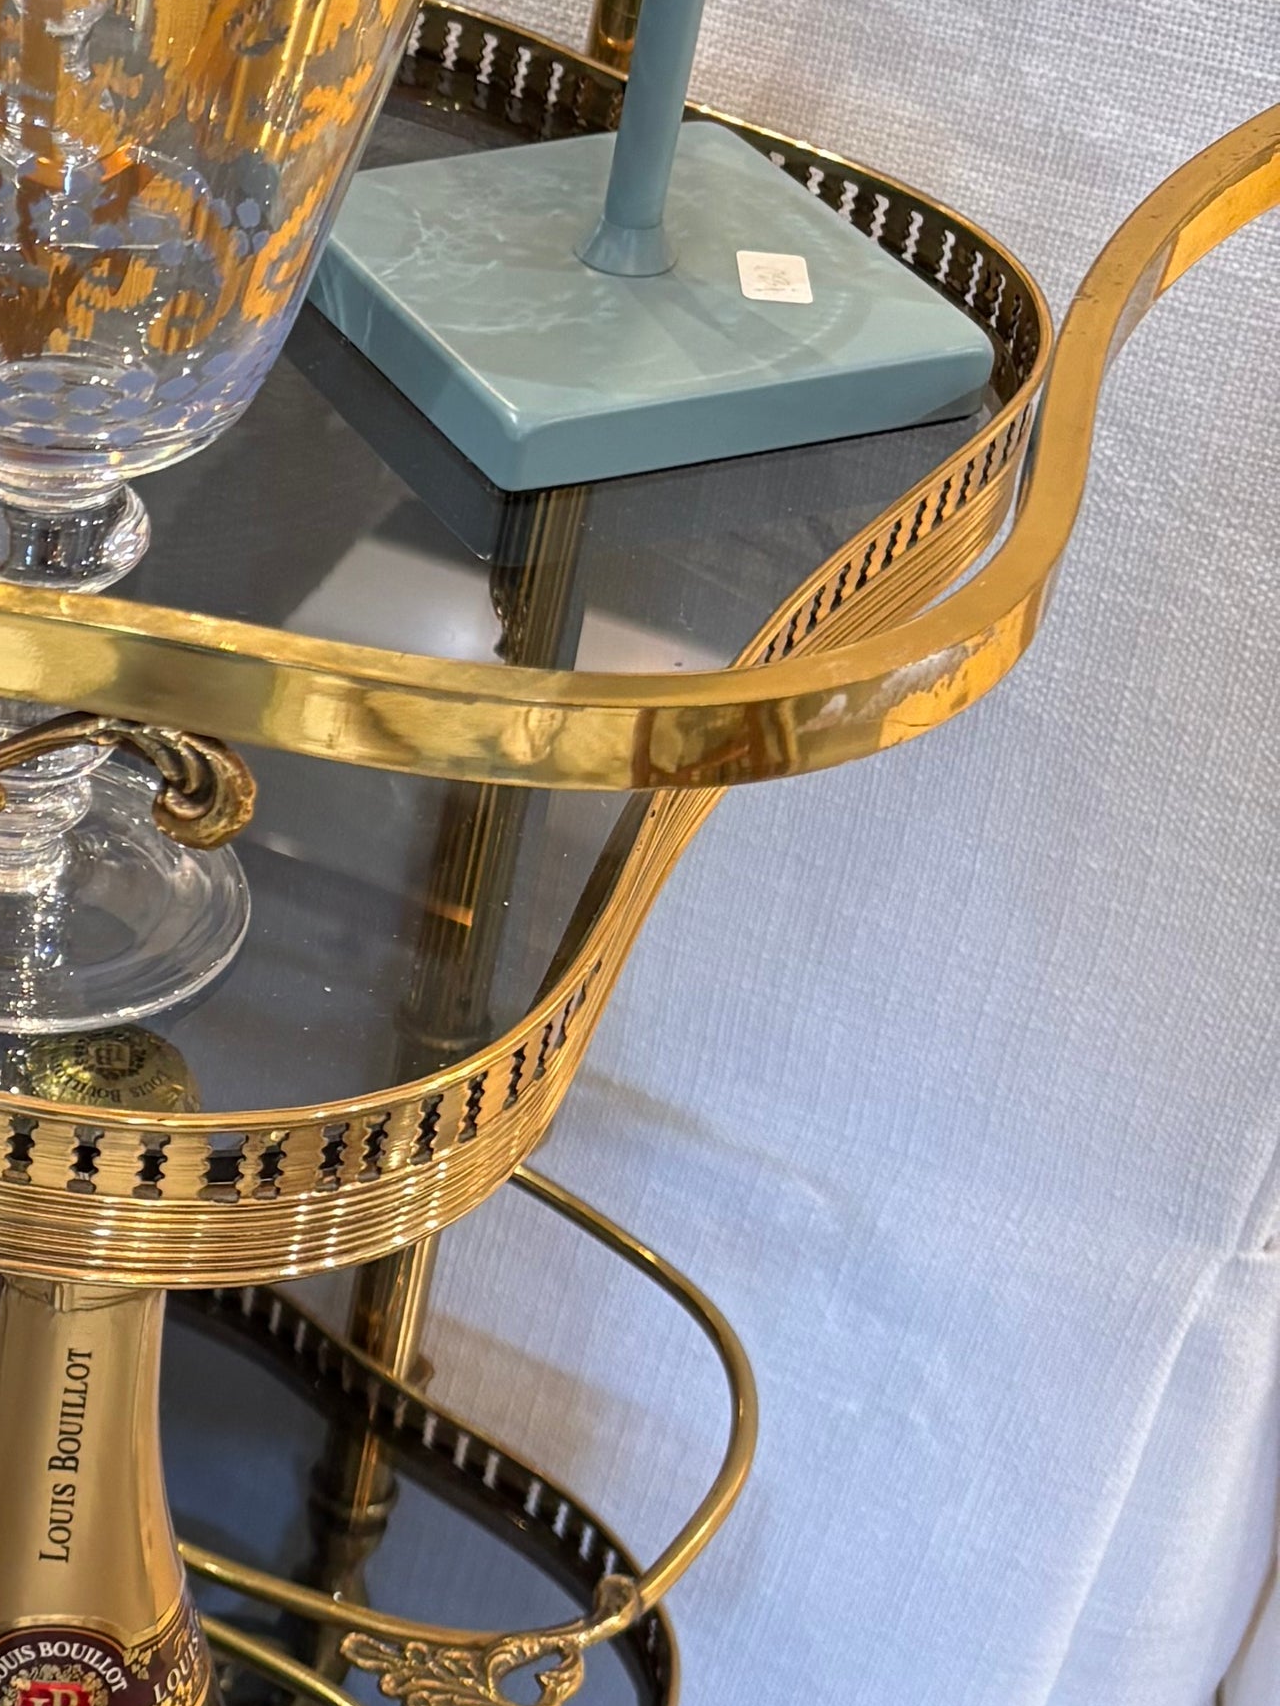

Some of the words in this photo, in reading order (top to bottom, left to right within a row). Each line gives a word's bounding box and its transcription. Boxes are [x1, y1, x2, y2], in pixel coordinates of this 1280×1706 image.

[47, 1348, 93, 1474] BOUILLOT
[38, 1483, 77, 1563] LOUIS
[37, 1640, 129, 1693] BOUILLOT
